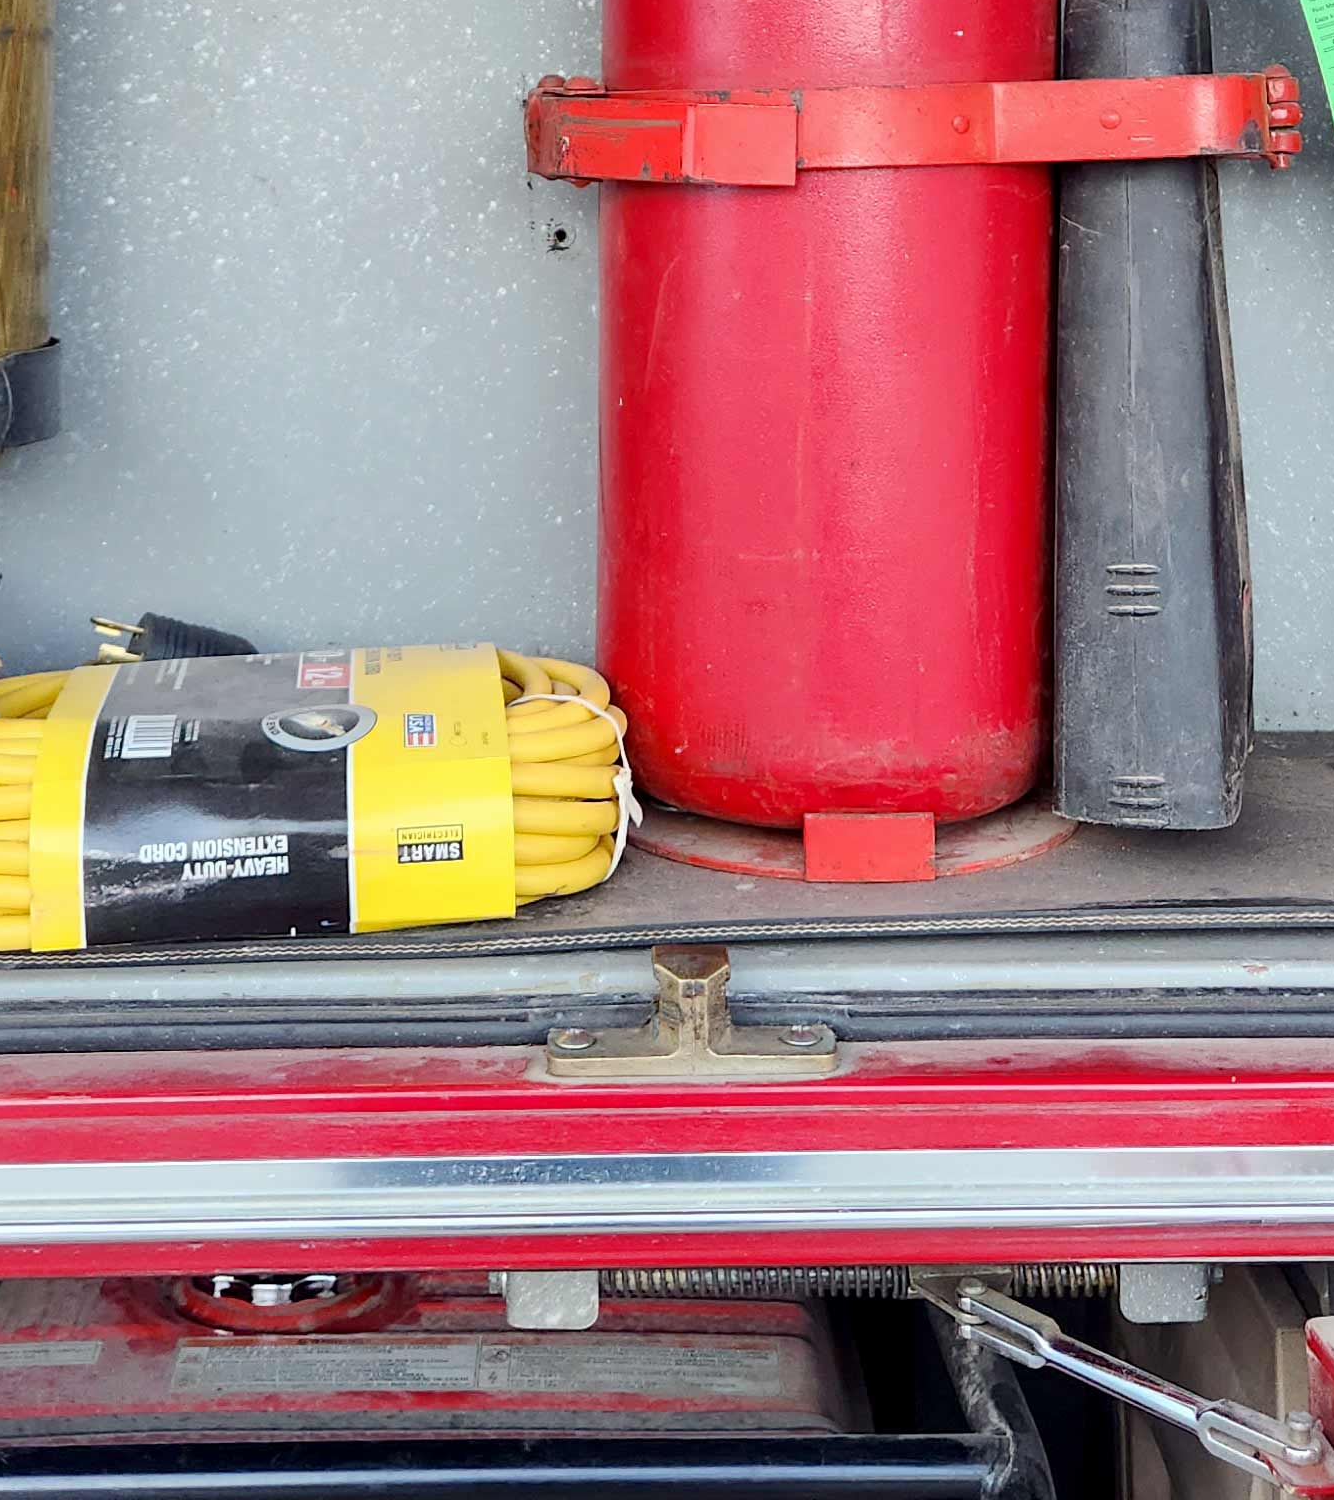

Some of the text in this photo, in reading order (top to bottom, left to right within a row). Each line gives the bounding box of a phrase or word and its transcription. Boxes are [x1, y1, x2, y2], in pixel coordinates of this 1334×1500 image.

[408, 715, 424, 733] USA
[402, 829, 459, 841] ELECTRICIAN
[139, 835, 289, 863] EXTENSION CORD
[400, 843, 461, 862] SMART
[181, 855, 290, 881] HEAVY-DUTY
